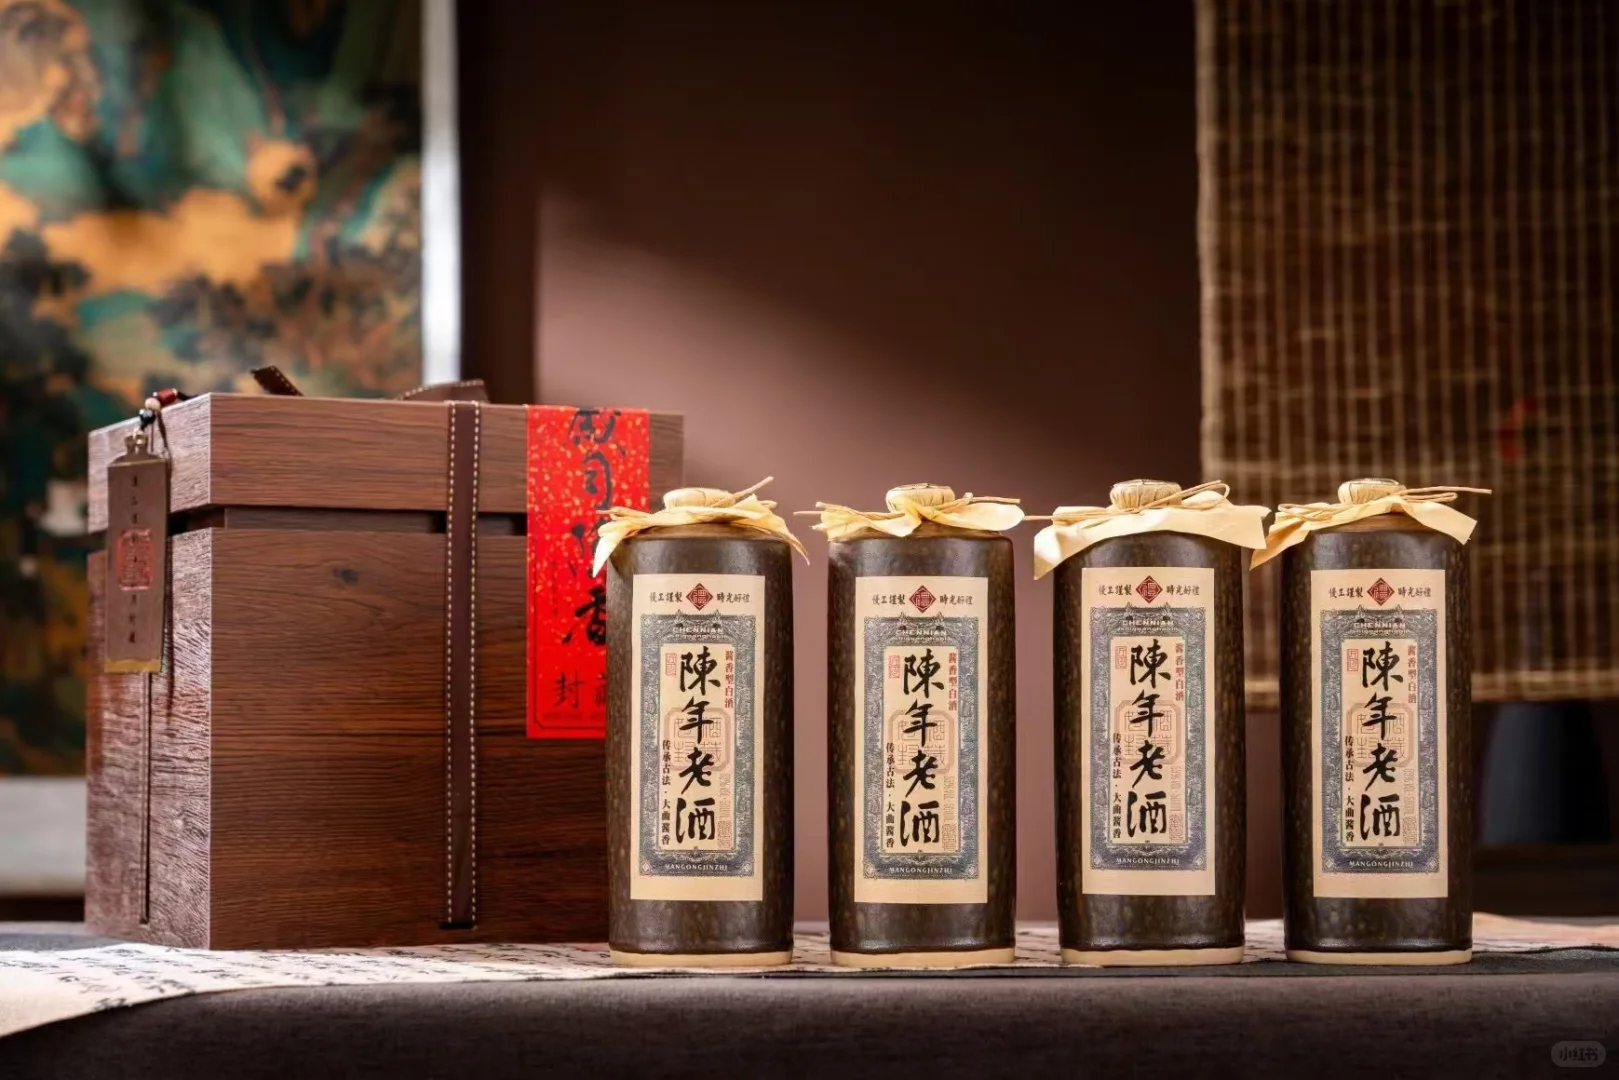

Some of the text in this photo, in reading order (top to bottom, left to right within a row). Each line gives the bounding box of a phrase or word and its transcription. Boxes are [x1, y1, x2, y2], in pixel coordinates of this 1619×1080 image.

[675, 645, 721, 844] 陳年老酒
[900, 648, 945, 847] 陳年老酒
[1127, 638, 1171, 838] 陳年老酒
[1359, 640, 1404, 841] 陳年老酒
[1116, 857, 1180, 865] MANGONGJINZHI
[1349, 860, 1414, 868] MANGONGJINZHI
